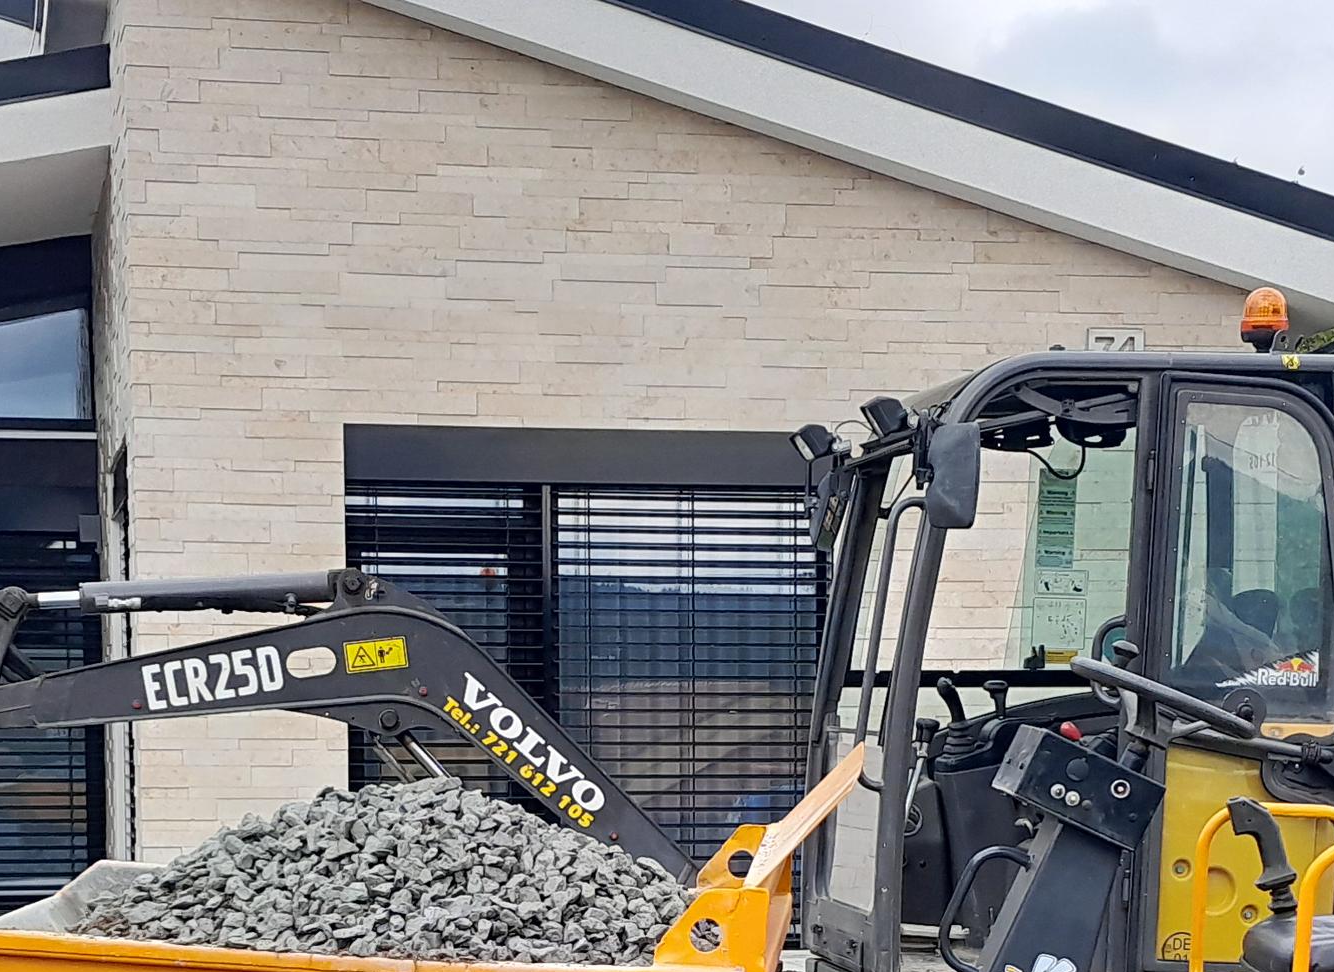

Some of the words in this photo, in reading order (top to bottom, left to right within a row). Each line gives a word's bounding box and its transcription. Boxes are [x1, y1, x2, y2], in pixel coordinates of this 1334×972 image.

[141, 646, 284, 710] ECR25D
[1257, 667, 1287, 686] Red
[1289, 671, 1317, 687] Bull
[464, 672, 605, 811] VOLVO
[482, 731, 518, 764] 721
[519, 764, 557, 797] 612
[558, 795, 594, 828] 105
